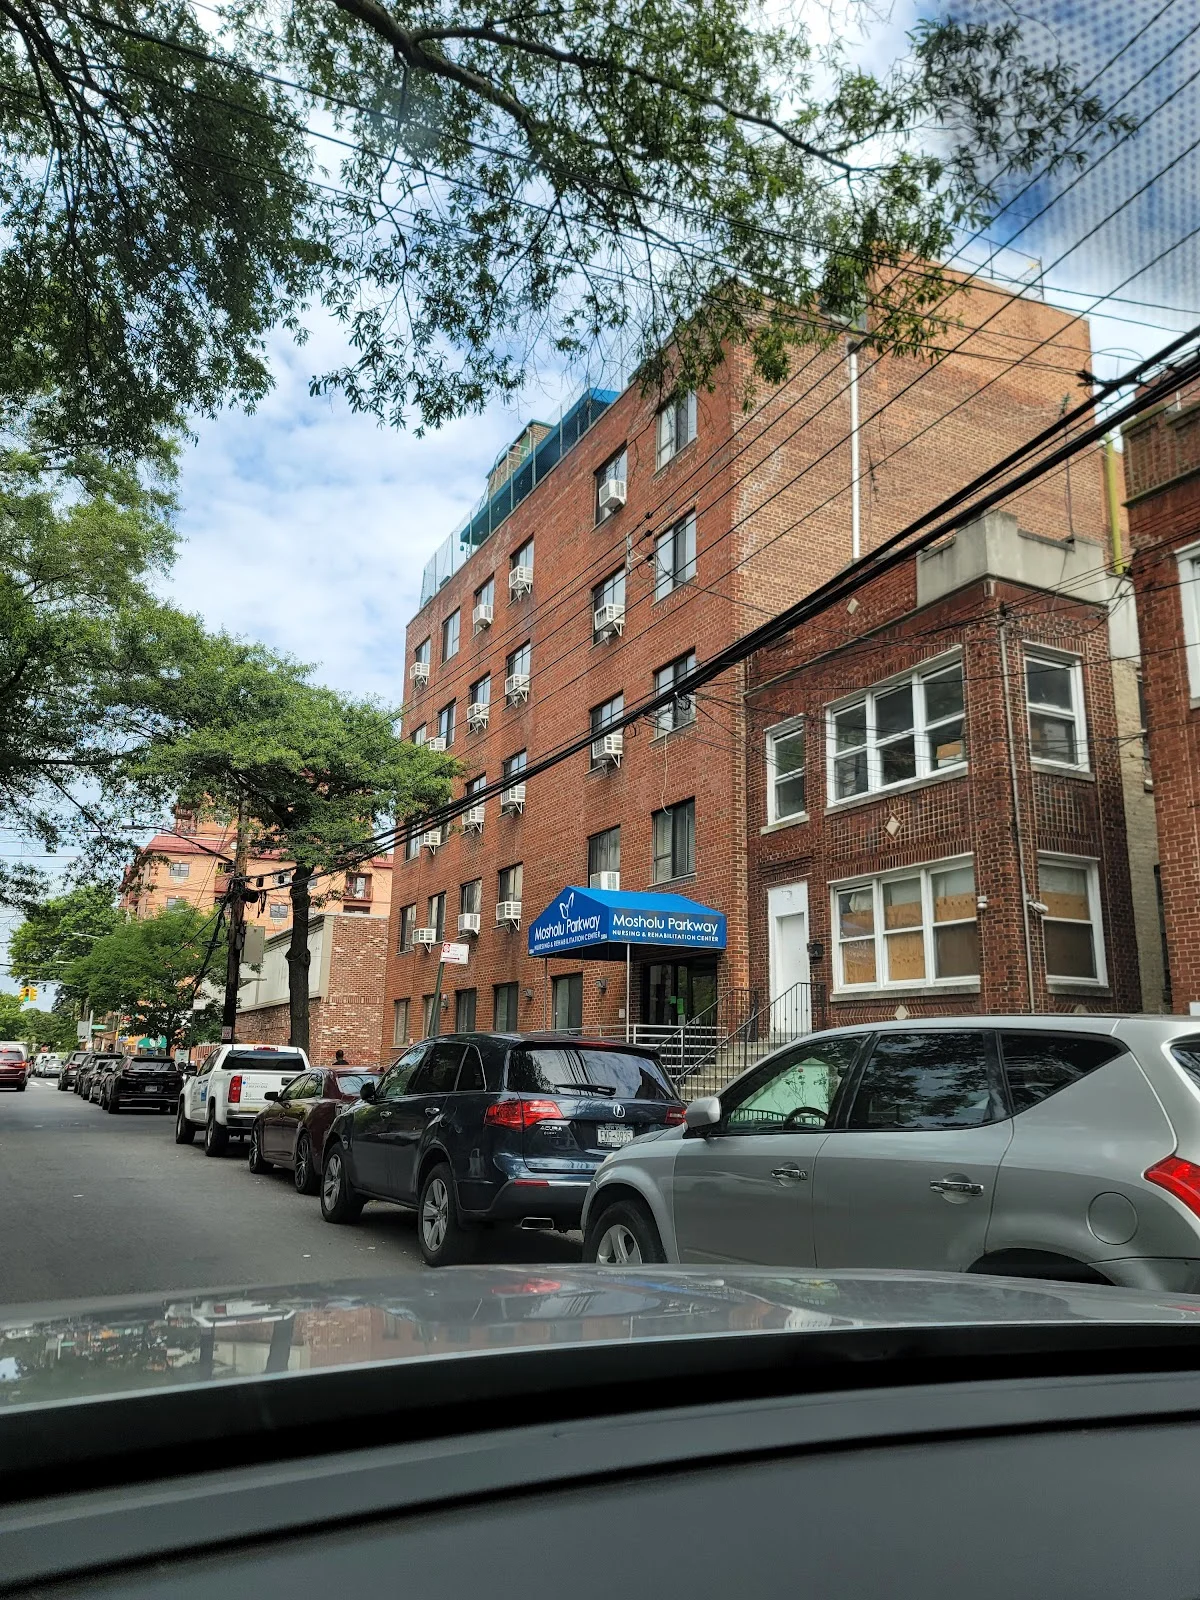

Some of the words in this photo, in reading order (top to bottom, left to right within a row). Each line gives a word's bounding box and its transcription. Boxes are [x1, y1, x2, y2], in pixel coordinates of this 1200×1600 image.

[534, 920, 565, 941] Mosholu
[566, 914, 601, 934] Parkway
[612, 913, 665, 929] Mosholu
[668, 917, 718, 935] Parkway
[534, 942, 551, 951] NURSING
[553, 935, 585, 947] REHABILITATION
[584, 931, 600, 940] CENTER
[612, 929, 641, 937] NURSING
[647, 931, 696, 941] REHABILITATION
